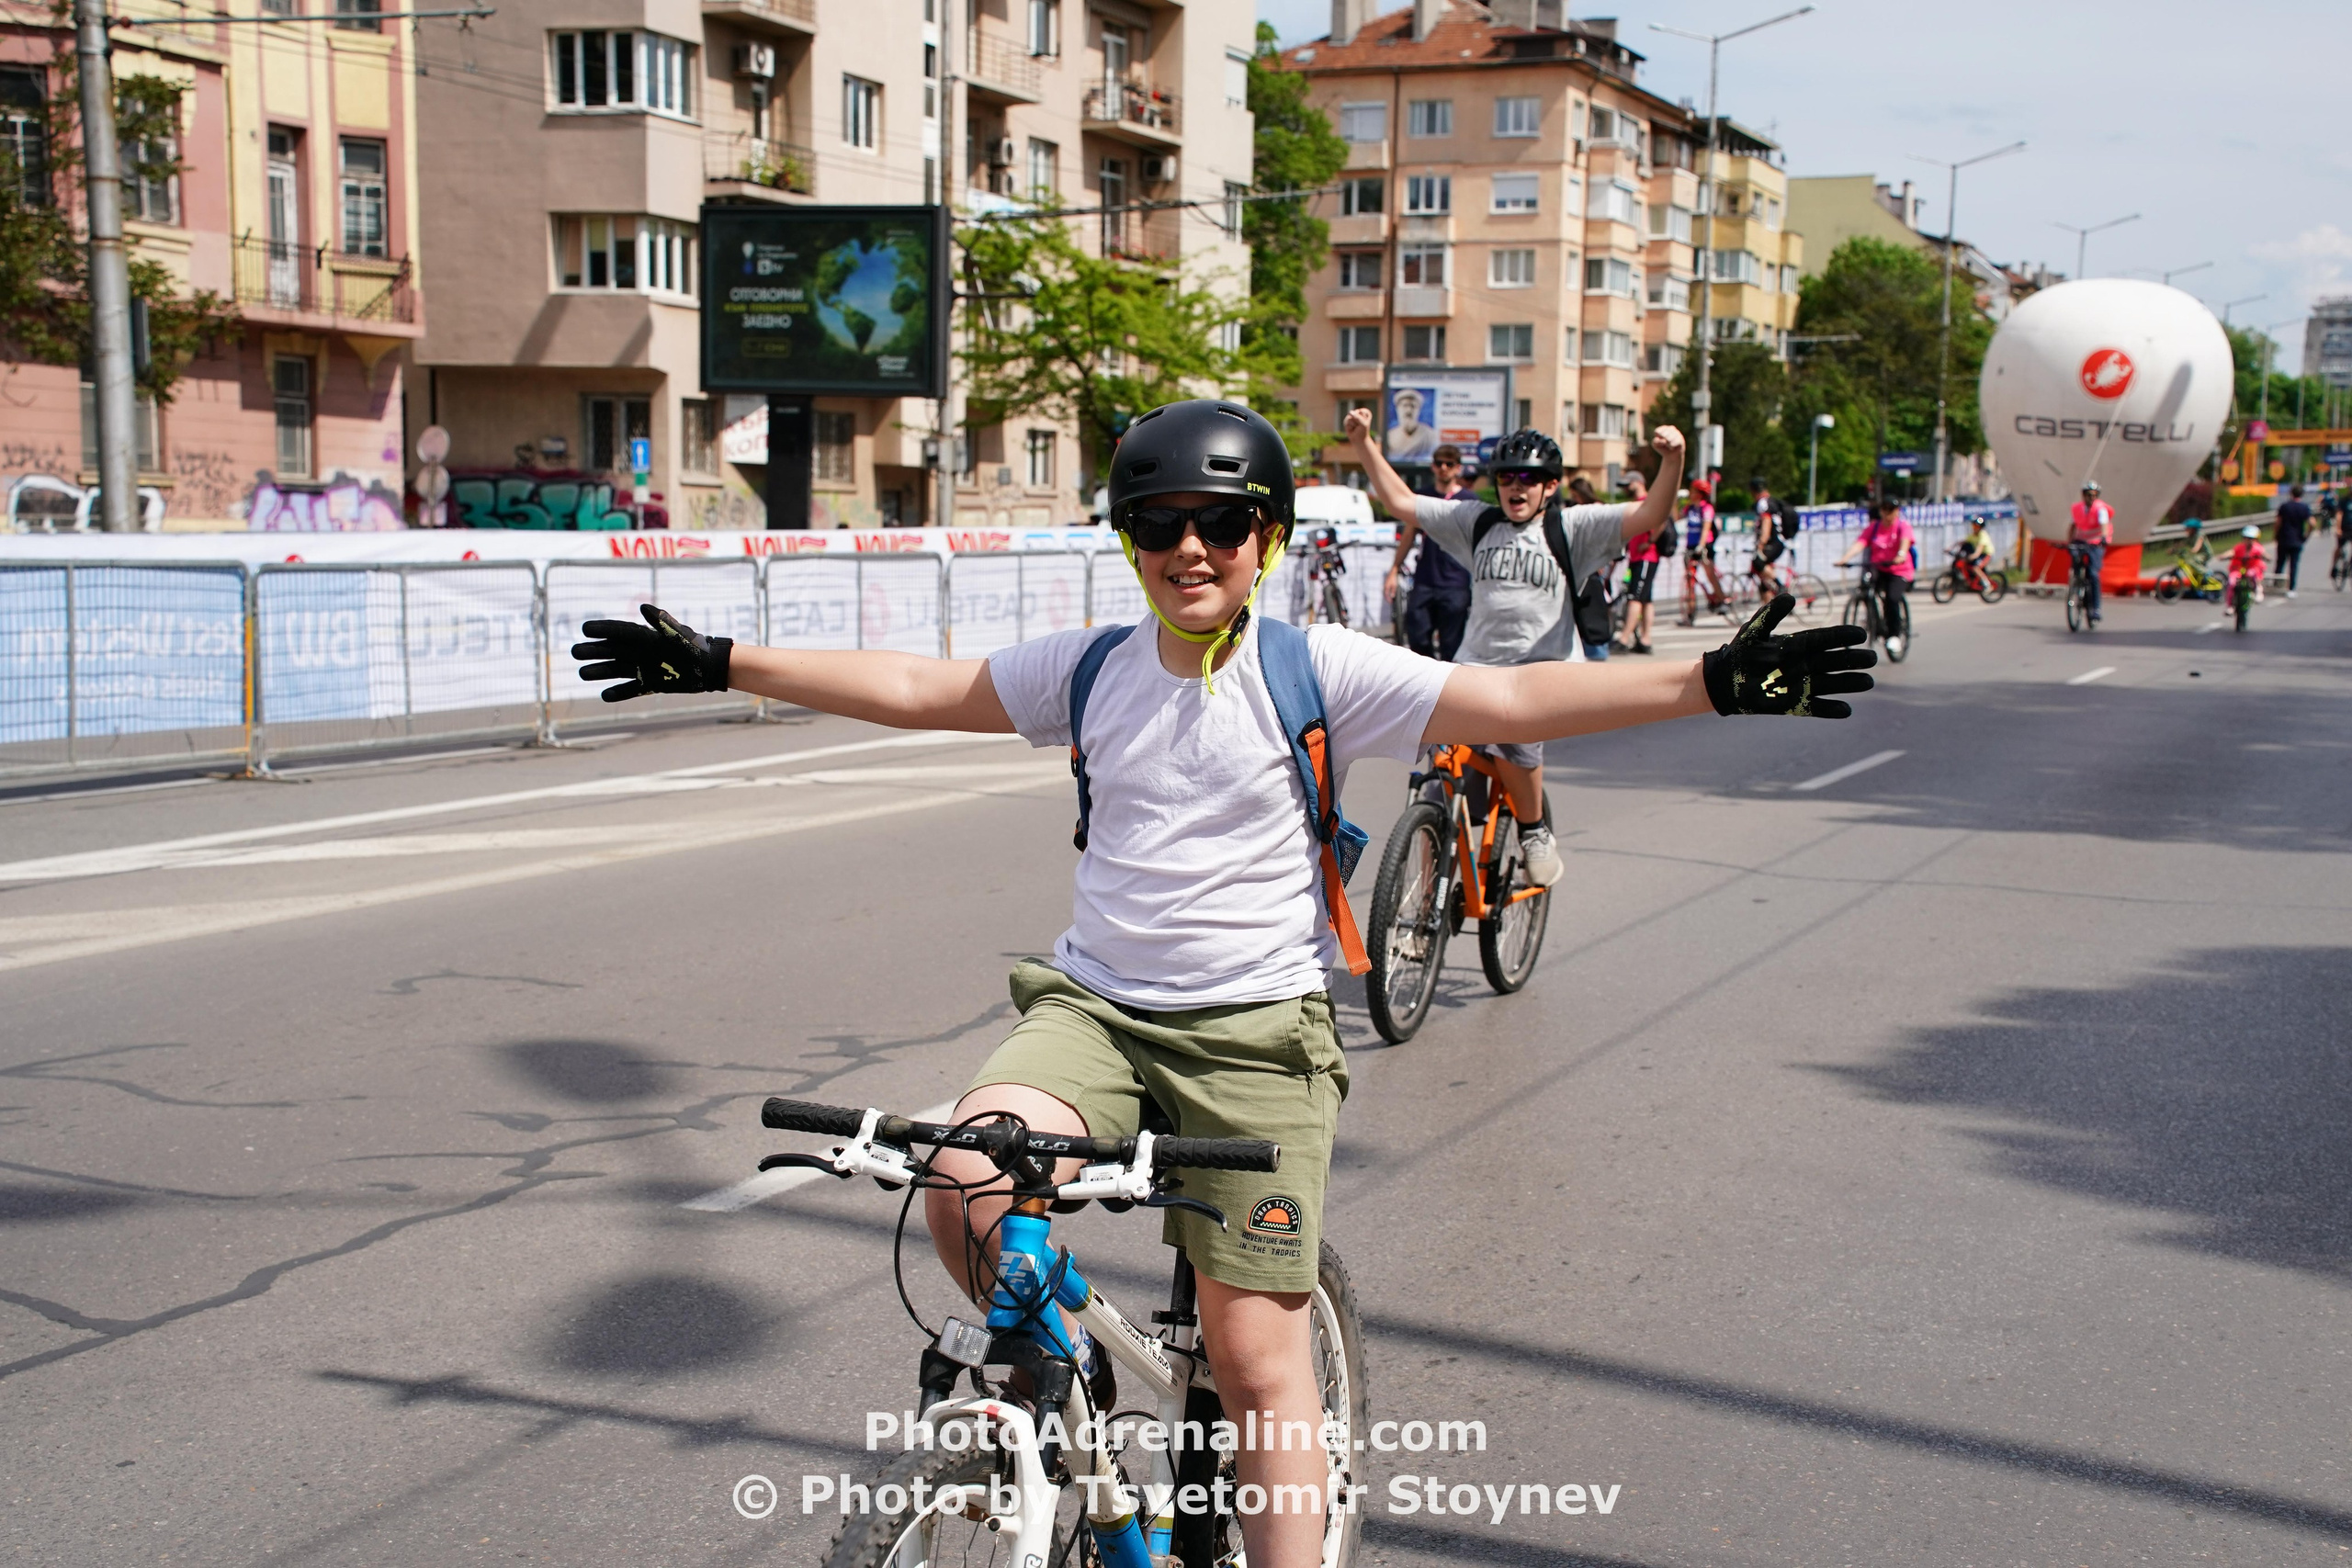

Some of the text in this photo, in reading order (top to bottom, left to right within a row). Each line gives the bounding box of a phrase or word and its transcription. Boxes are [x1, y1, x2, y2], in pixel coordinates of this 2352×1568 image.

[1247, 481, 1271, 496] BTWIN
[1474, 540, 1559, 597] OKÉMON
[1254, 1201, 1298, 1225] DARK TROPICS
[1241, 1231, 1303, 1247] ADVENTURE AWAITS
[1238, 1241, 1301, 1258] IN THE TROPICS
[1120, 1317, 1170, 1370] ROOKIE TEAM
